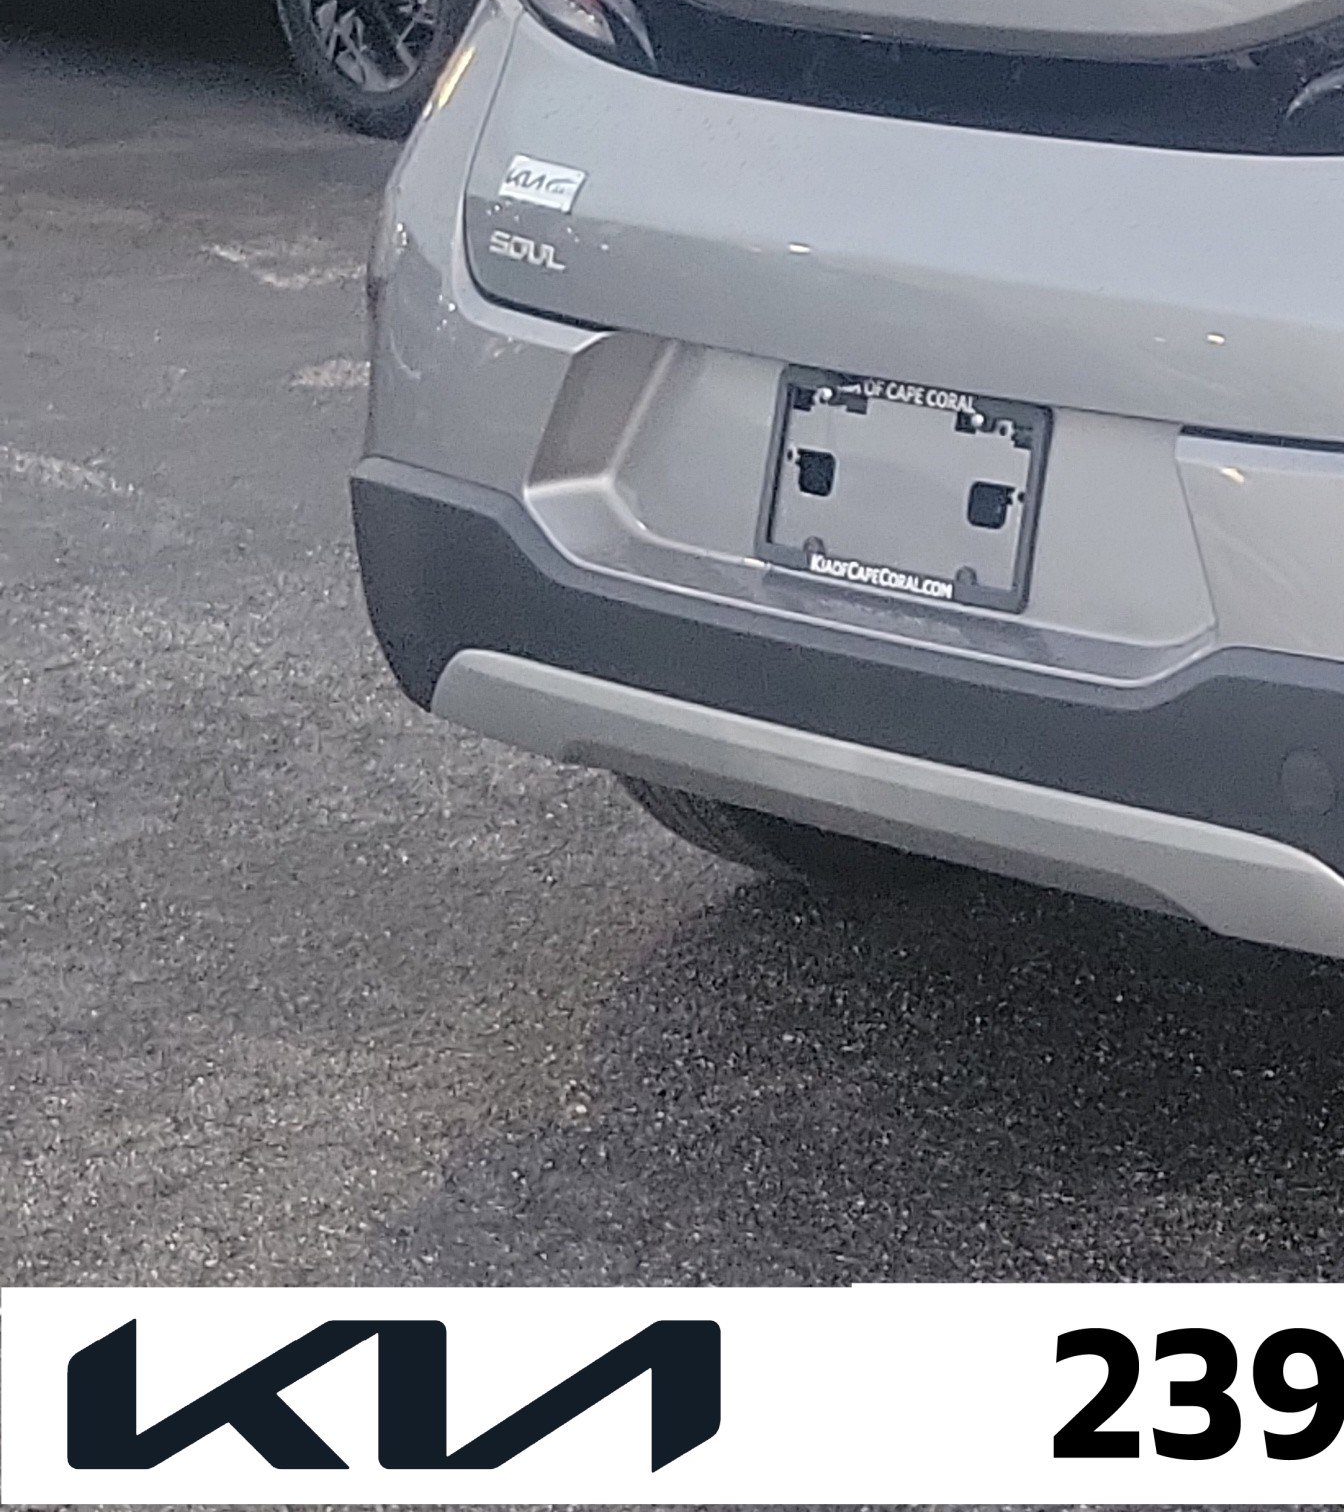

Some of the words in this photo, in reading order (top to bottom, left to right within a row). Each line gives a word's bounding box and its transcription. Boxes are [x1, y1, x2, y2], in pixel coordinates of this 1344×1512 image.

[489, 229, 566, 271] SOUL
[886, 382, 925, 405] CAPE
[926, 389, 977, 415] CORAL
